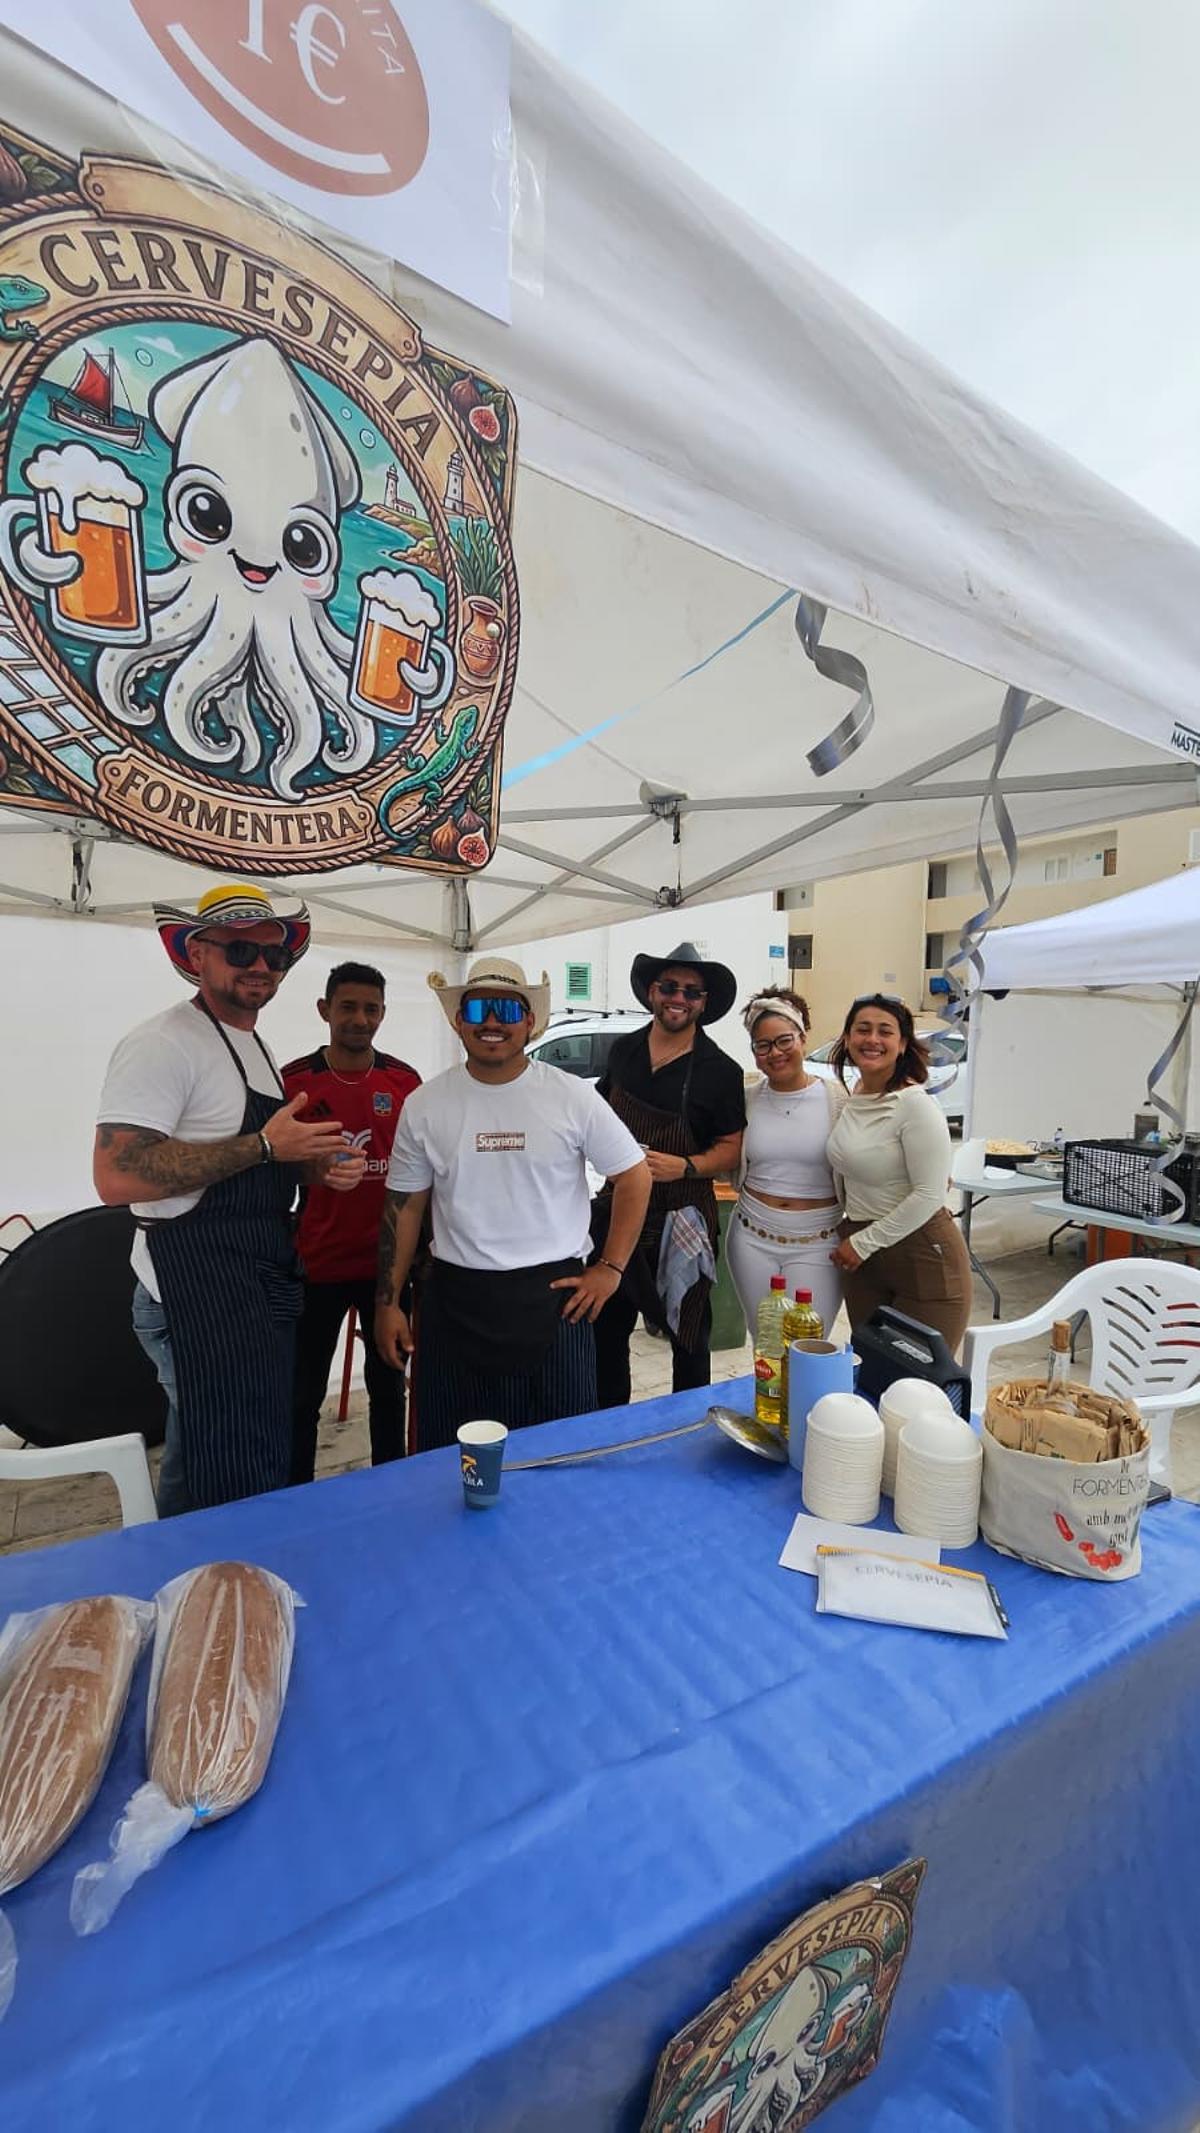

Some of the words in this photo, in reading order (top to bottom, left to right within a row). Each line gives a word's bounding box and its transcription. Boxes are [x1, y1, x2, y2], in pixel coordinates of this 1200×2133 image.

[354, 0, 406, 75] ITA
[39, 229, 443, 462] CERVESEPIA
[116, 765, 362, 845] FORMENTERA
[478, 1134, 525, 1150] Supreme
[709, 1906, 885, 2045] CERVESEPIA
